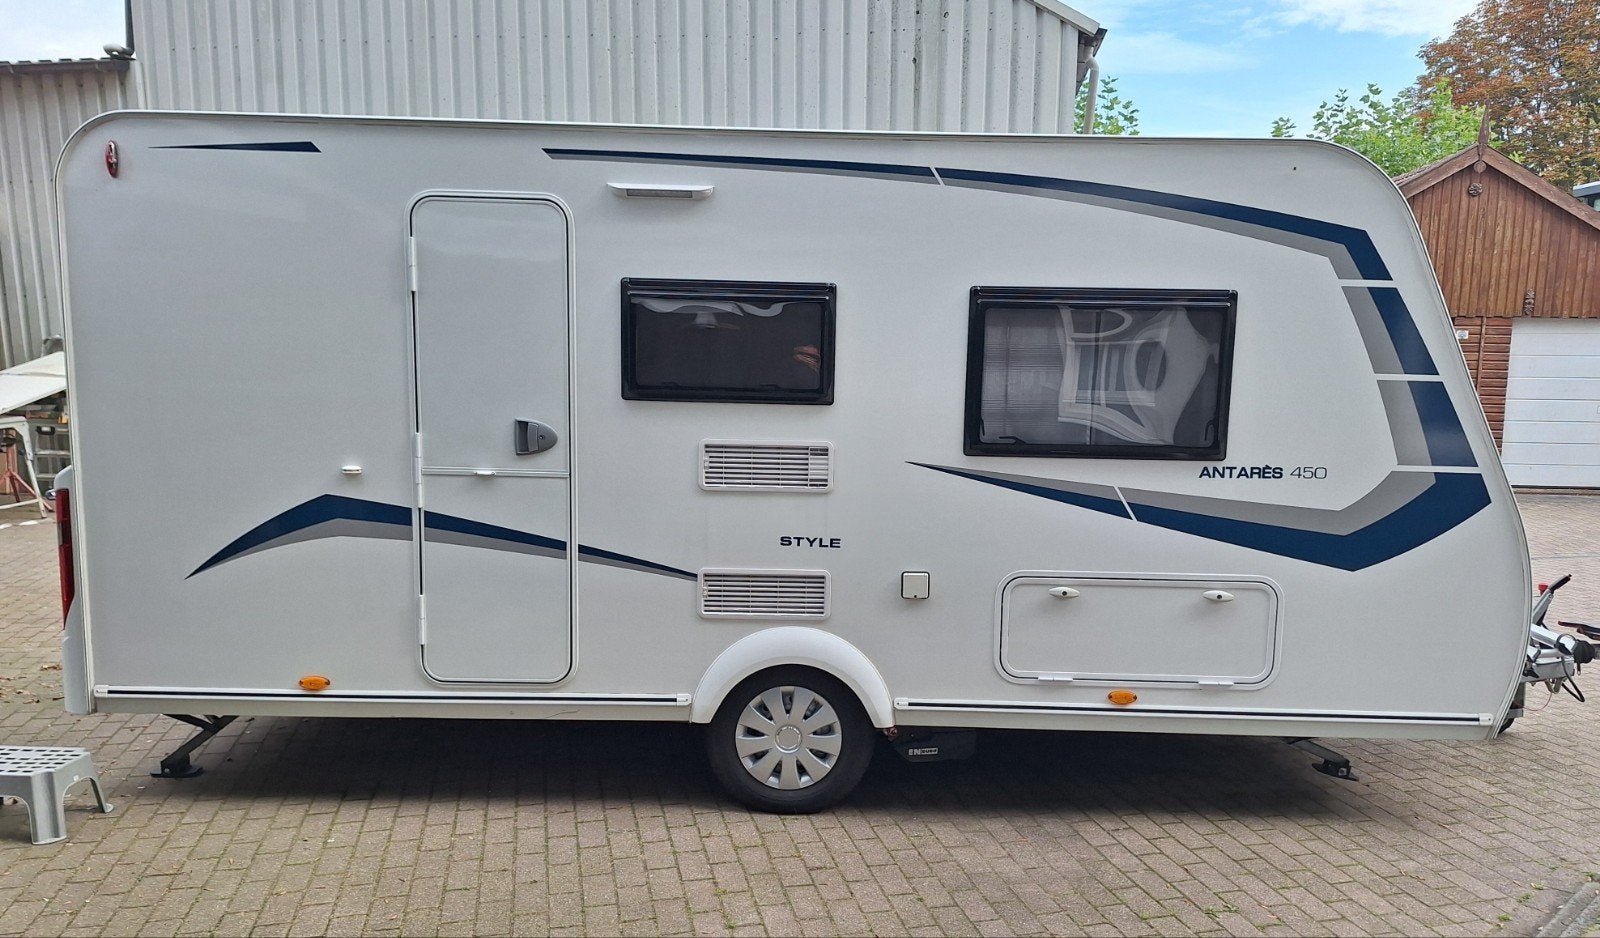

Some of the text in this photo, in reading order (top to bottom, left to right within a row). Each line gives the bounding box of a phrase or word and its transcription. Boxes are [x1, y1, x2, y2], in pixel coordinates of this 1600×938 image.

[1198, 464, 1328, 479] ANTARÈS 450
[780, 536, 841, 548] STYLE
